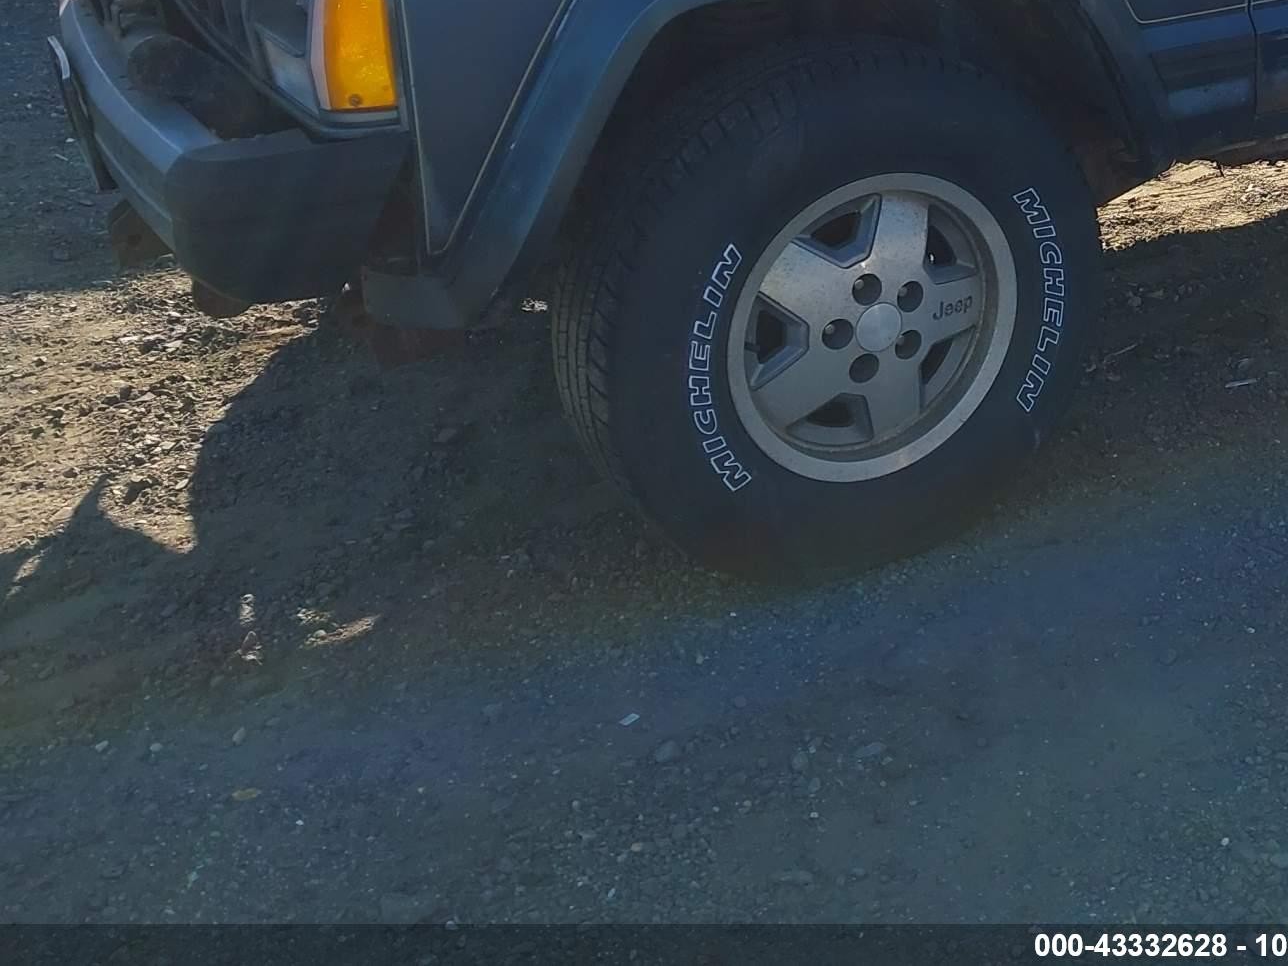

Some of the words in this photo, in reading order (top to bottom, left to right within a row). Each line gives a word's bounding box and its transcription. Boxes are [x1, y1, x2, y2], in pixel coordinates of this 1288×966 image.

[688, 243, 752, 492] MICHELIN
[932, 295, 973, 321] Jeep
[1013, 187, 1065, 413] MICHELIN
